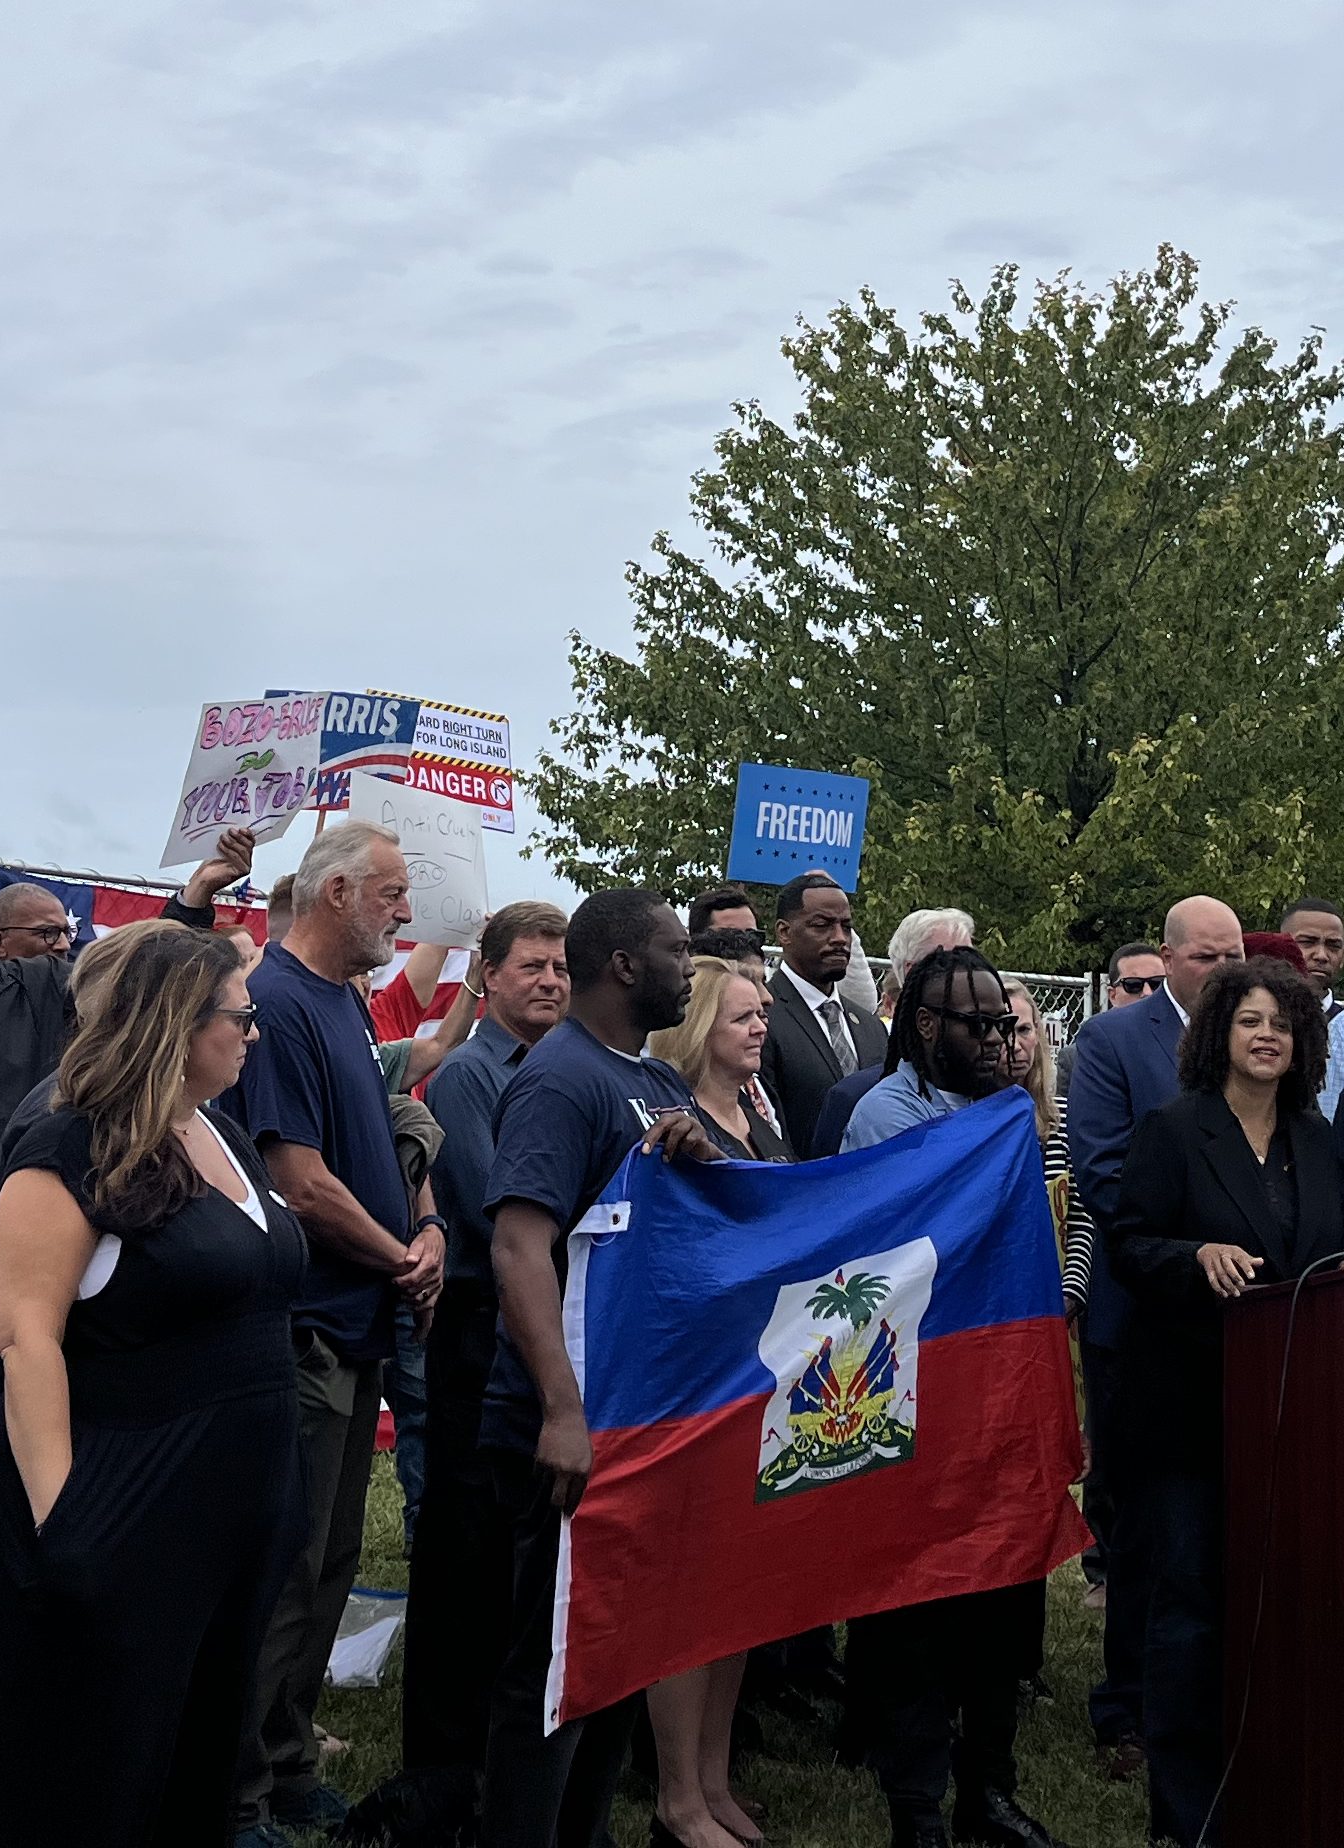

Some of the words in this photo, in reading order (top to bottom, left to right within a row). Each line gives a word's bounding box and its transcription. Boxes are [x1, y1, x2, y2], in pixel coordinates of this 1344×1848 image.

[326, 695, 401, 737] RRIS
[417, 715, 440, 730] ARD
[442, 719, 473, 736] RIGHT
[475, 726, 503, 743] TURN
[416, 730, 438, 746] FOR
[439, 735, 469, 752] LONG
[470, 741, 507, 759] ISLAND
[756, 801, 854, 849] FREEDOM
